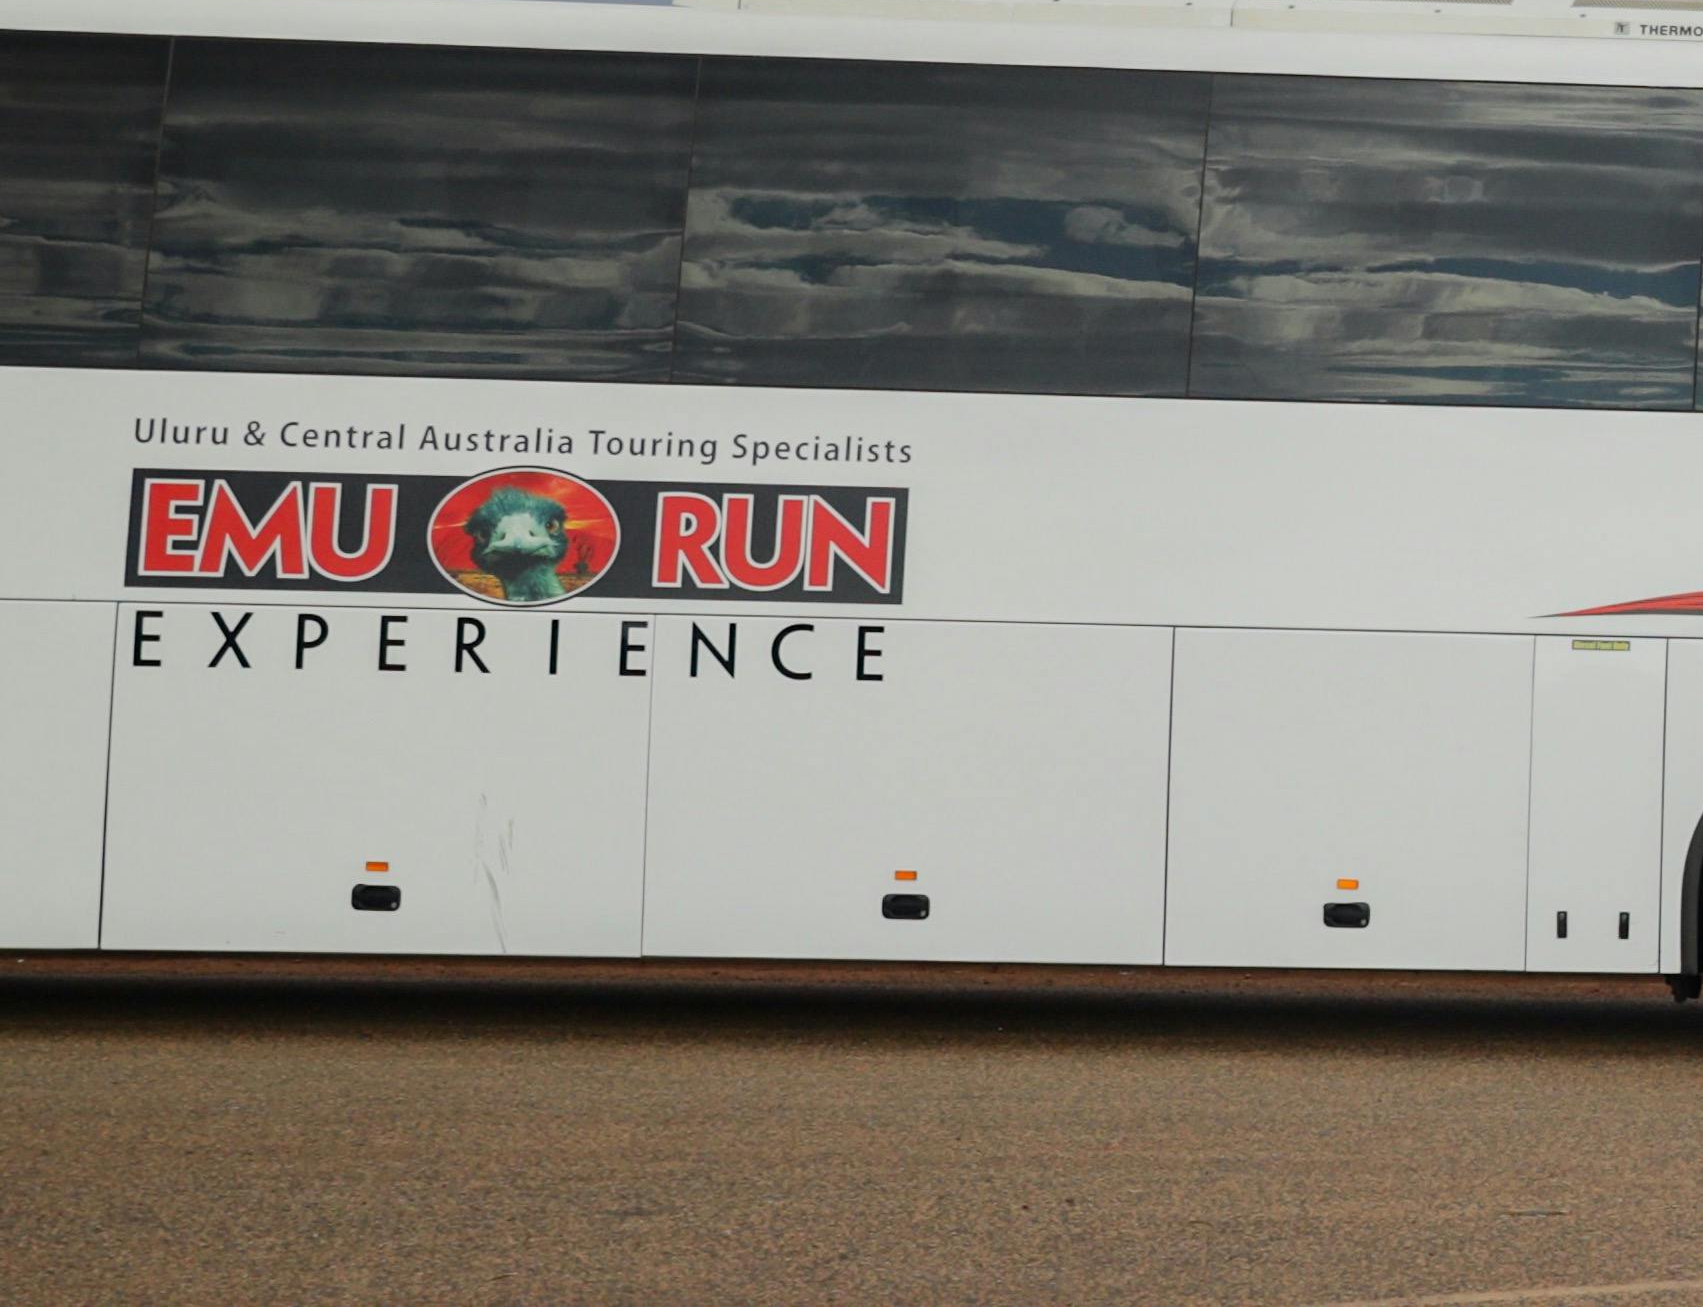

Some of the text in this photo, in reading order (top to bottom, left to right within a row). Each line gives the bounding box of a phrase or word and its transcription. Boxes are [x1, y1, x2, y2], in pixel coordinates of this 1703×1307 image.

[1640, 24, 1703, 37] THERMO
[134, 417, 912, 466] Uluru & Central Australia Touring Specialists
[138, 478, 896, 594] EMU RUN
[132, 610, 886, 682] EXPERIENCE
